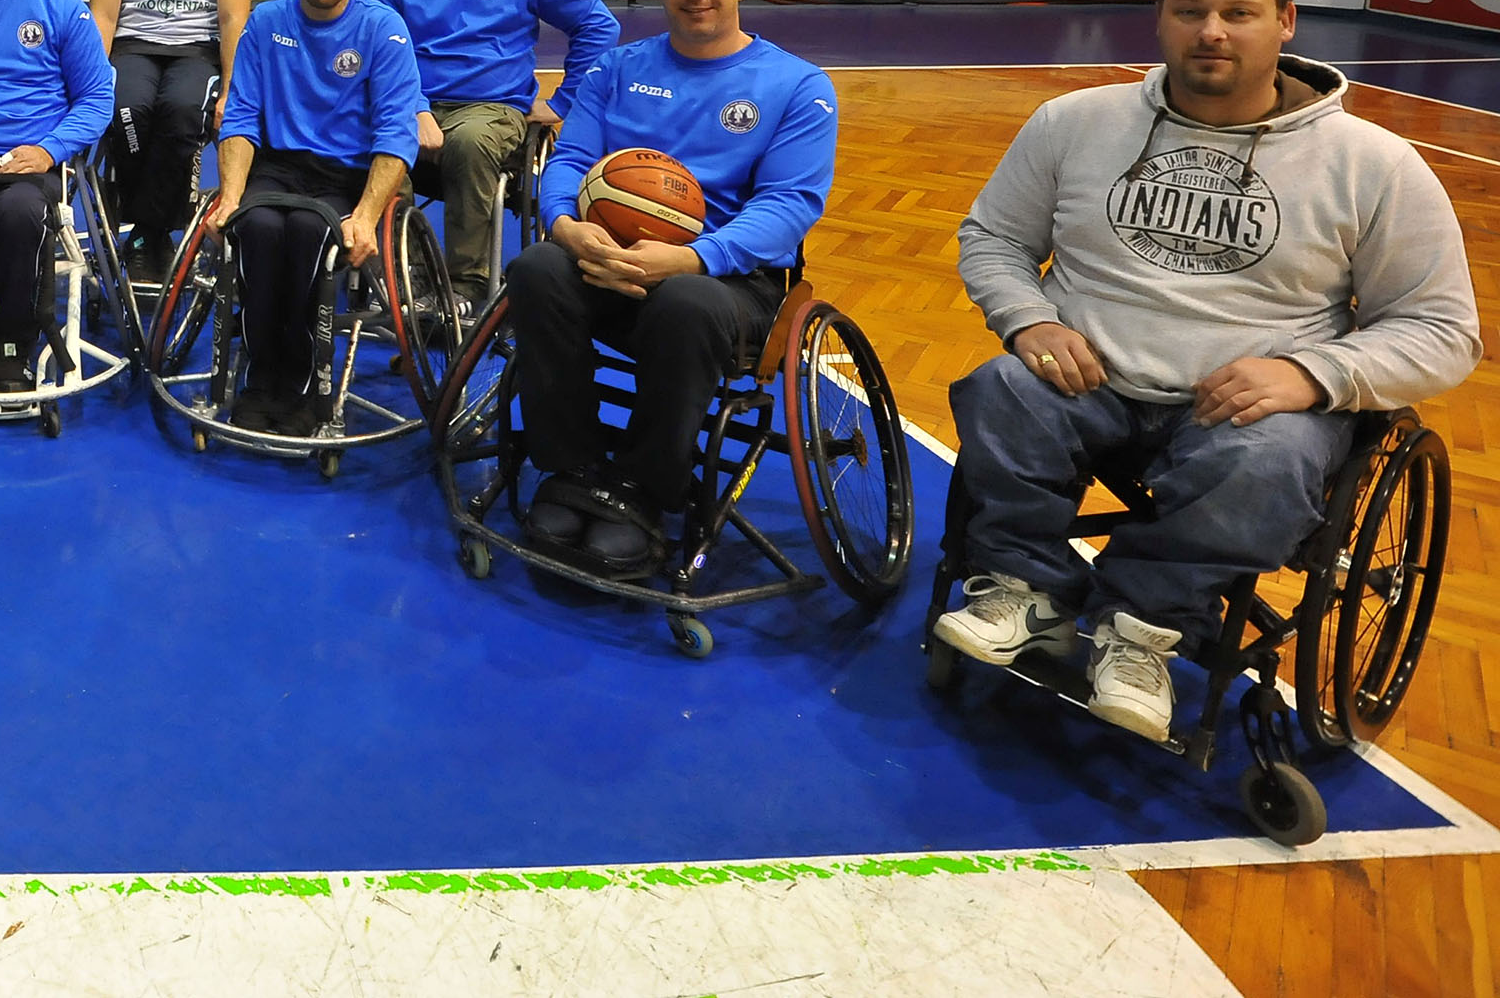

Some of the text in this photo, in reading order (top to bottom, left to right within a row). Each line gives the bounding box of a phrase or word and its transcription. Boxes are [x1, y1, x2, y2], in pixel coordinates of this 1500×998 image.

[124, 123, 140, 154] VODICE
[1162, 150, 1198, 169] TAILOR
[1204, 153, 1237, 175] SINCE
[663, 175, 689, 194] FIBA
[1116, 183, 1267, 248] INDIANS
[1127, 231, 1245, 272] WORLD CHAMPIONSHIP
[1172, 238, 1198, 252] TM
